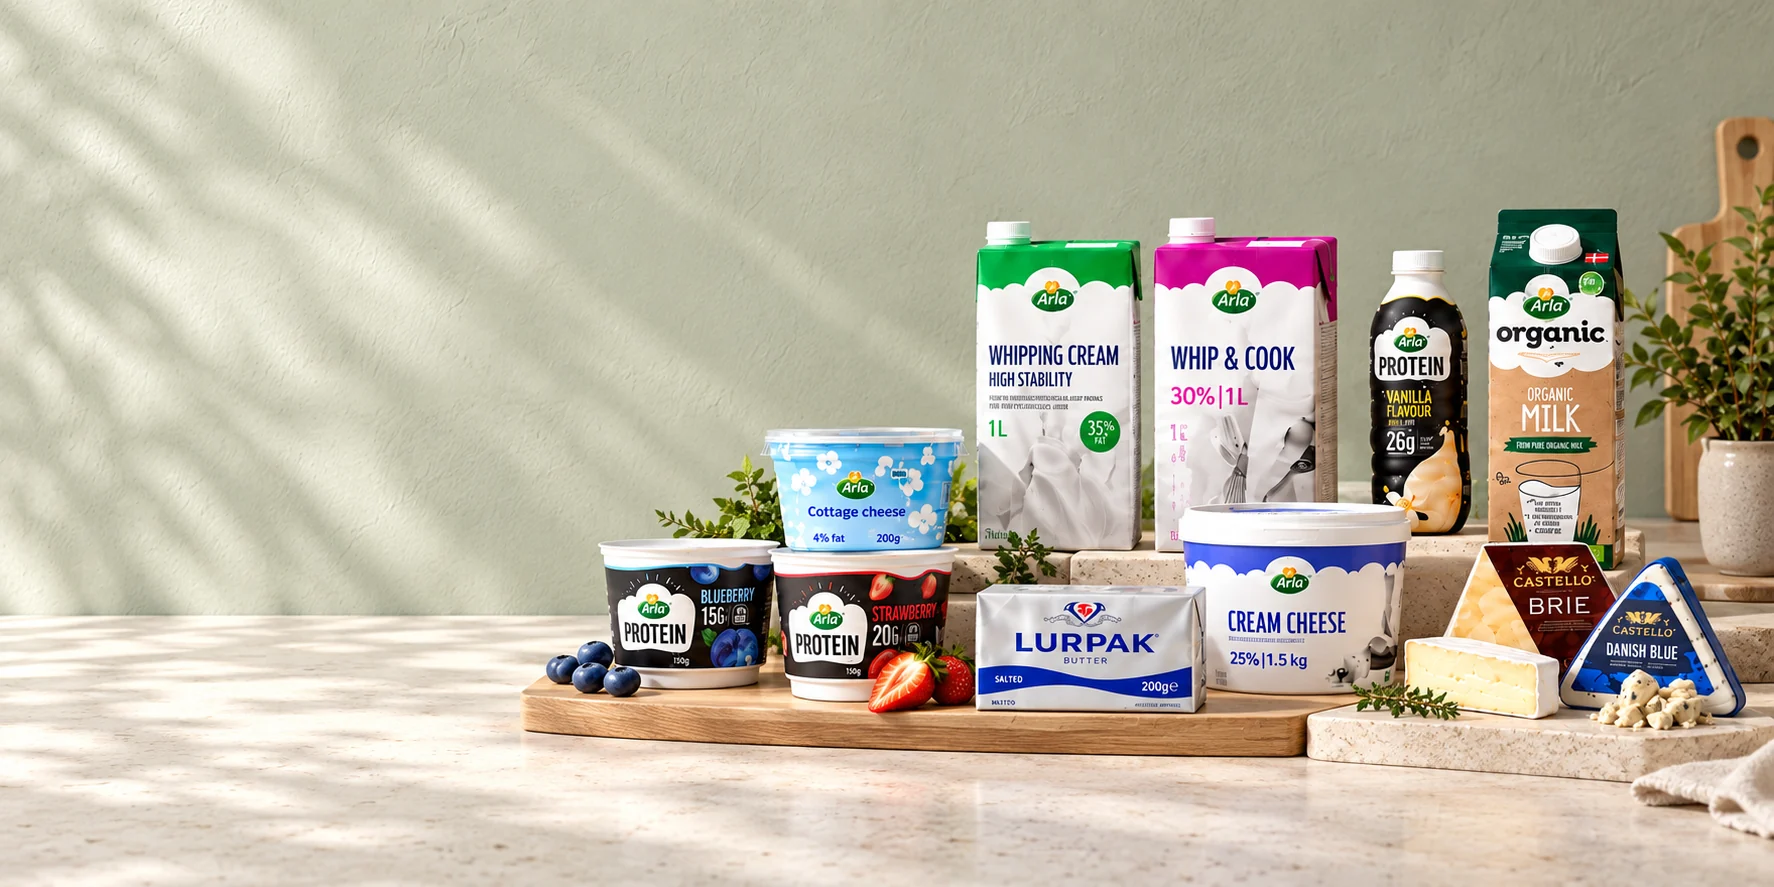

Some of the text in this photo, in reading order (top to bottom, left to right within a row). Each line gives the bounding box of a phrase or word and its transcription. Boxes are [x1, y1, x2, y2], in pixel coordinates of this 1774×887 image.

[1037, 293, 1067, 305] Arla
[1218, 293, 1249, 307] Arla
[1530, 300, 1563, 312] Arla
[1398, 336, 1423, 347] Arla
[1496, 320, 1605, 349] organic
[988, 345, 1119, 366] WHIPPING CREAM
[1170, 346, 1295, 370] WHIP & COOK
[1379, 356, 1444, 376] PROTEIN
[989, 372, 1072, 387] HIGH STABILITY
[1386, 390, 1432, 404] VANILLA
[1527, 387, 1574, 401] ORGANIC
[1387, 405, 1431, 417] FLAVOUR
[1522, 404, 1581, 432] MILK
[1088, 420, 1115, 436] 35%
[1094, 437, 1106, 445] FAT
[1386, 430, 1415, 455] 26g
[841, 482, 869, 493] Arla
[808, 506, 906, 520] Cottage cheese
[813, 533, 845, 543] 4% fat
[876, 534, 901, 544] 200g
[1277, 577, 1303, 588] Arla
[1513, 575, 1592, 588] CASTELLO
[701, 587, 755, 604] BLUEBERRY
[641, 603, 665, 614] Arla
[871, 602, 938, 622] STRAWBERRY
[1529, 596, 1590, 615] BRIE
[701, 606, 725, 626] 15G
[814, 614, 838, 625] Arla
[1228, 610, 1346, 634] CREAM CHEESE
[624, 622, 686, 644] PROTEIN
[872, 624, 899, 646] 20G
[1612, 625, 1673, 638] CASTELLO
[795, 633, 859, 656] PROTEIN
[1015, 633, 1155, 653] LURPAK
[1606, 642, 1678, 660] DANISH BLUE
[1291, 652, 1308, 669] kg
[846, 667, 861, 676] 150g
[995, 675, 1023, 683] SALTED
